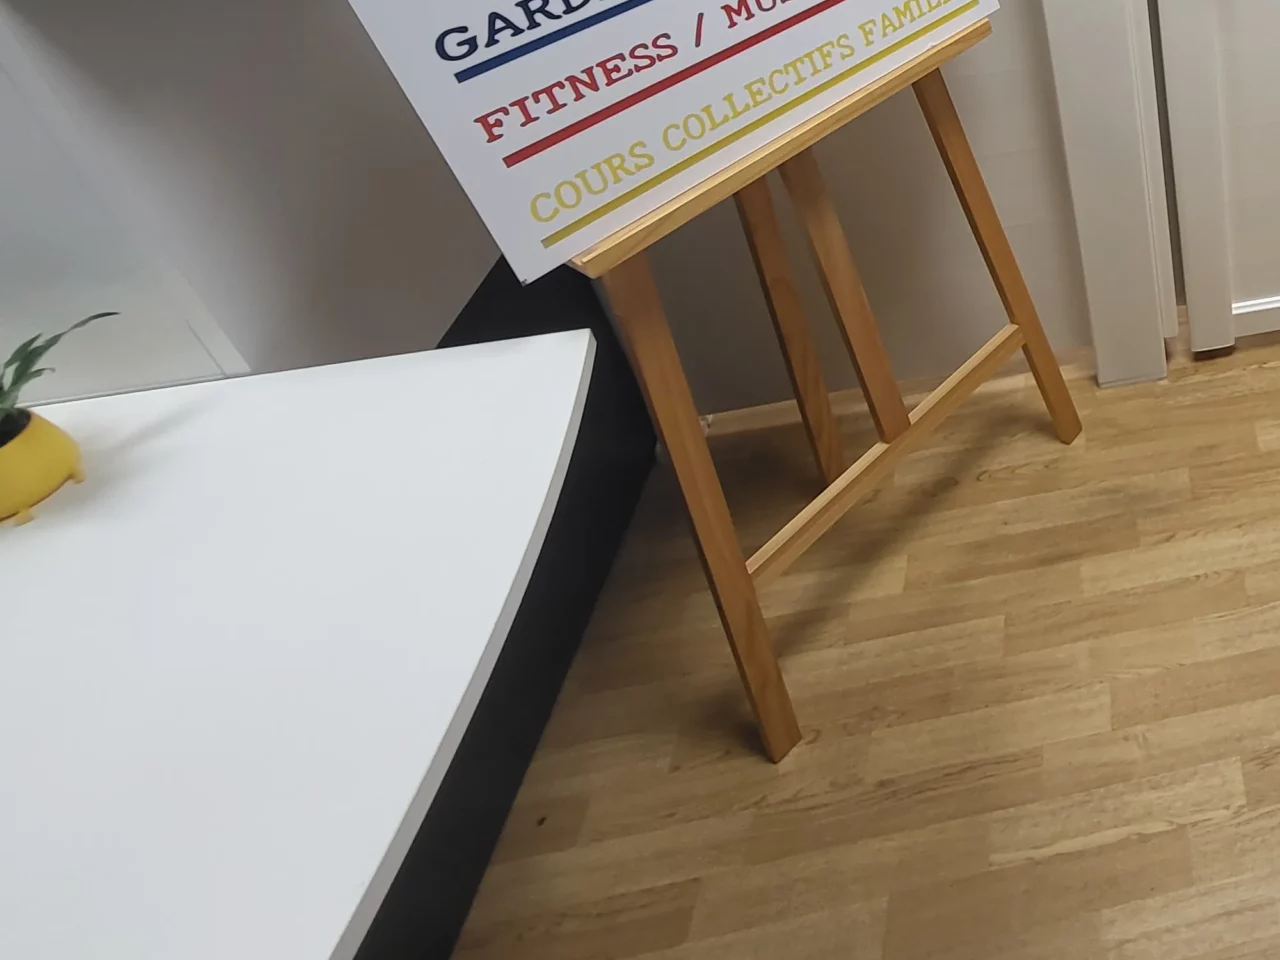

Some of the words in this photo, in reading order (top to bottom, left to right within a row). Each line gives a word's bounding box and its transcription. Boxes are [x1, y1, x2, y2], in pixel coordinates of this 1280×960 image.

[473, 32, 679, 143] FITNESS
[694, 13, 705, 48] /
[529, 141, 656, 224] COURS
[660, 34, 858, 152] COLLECTIFS
